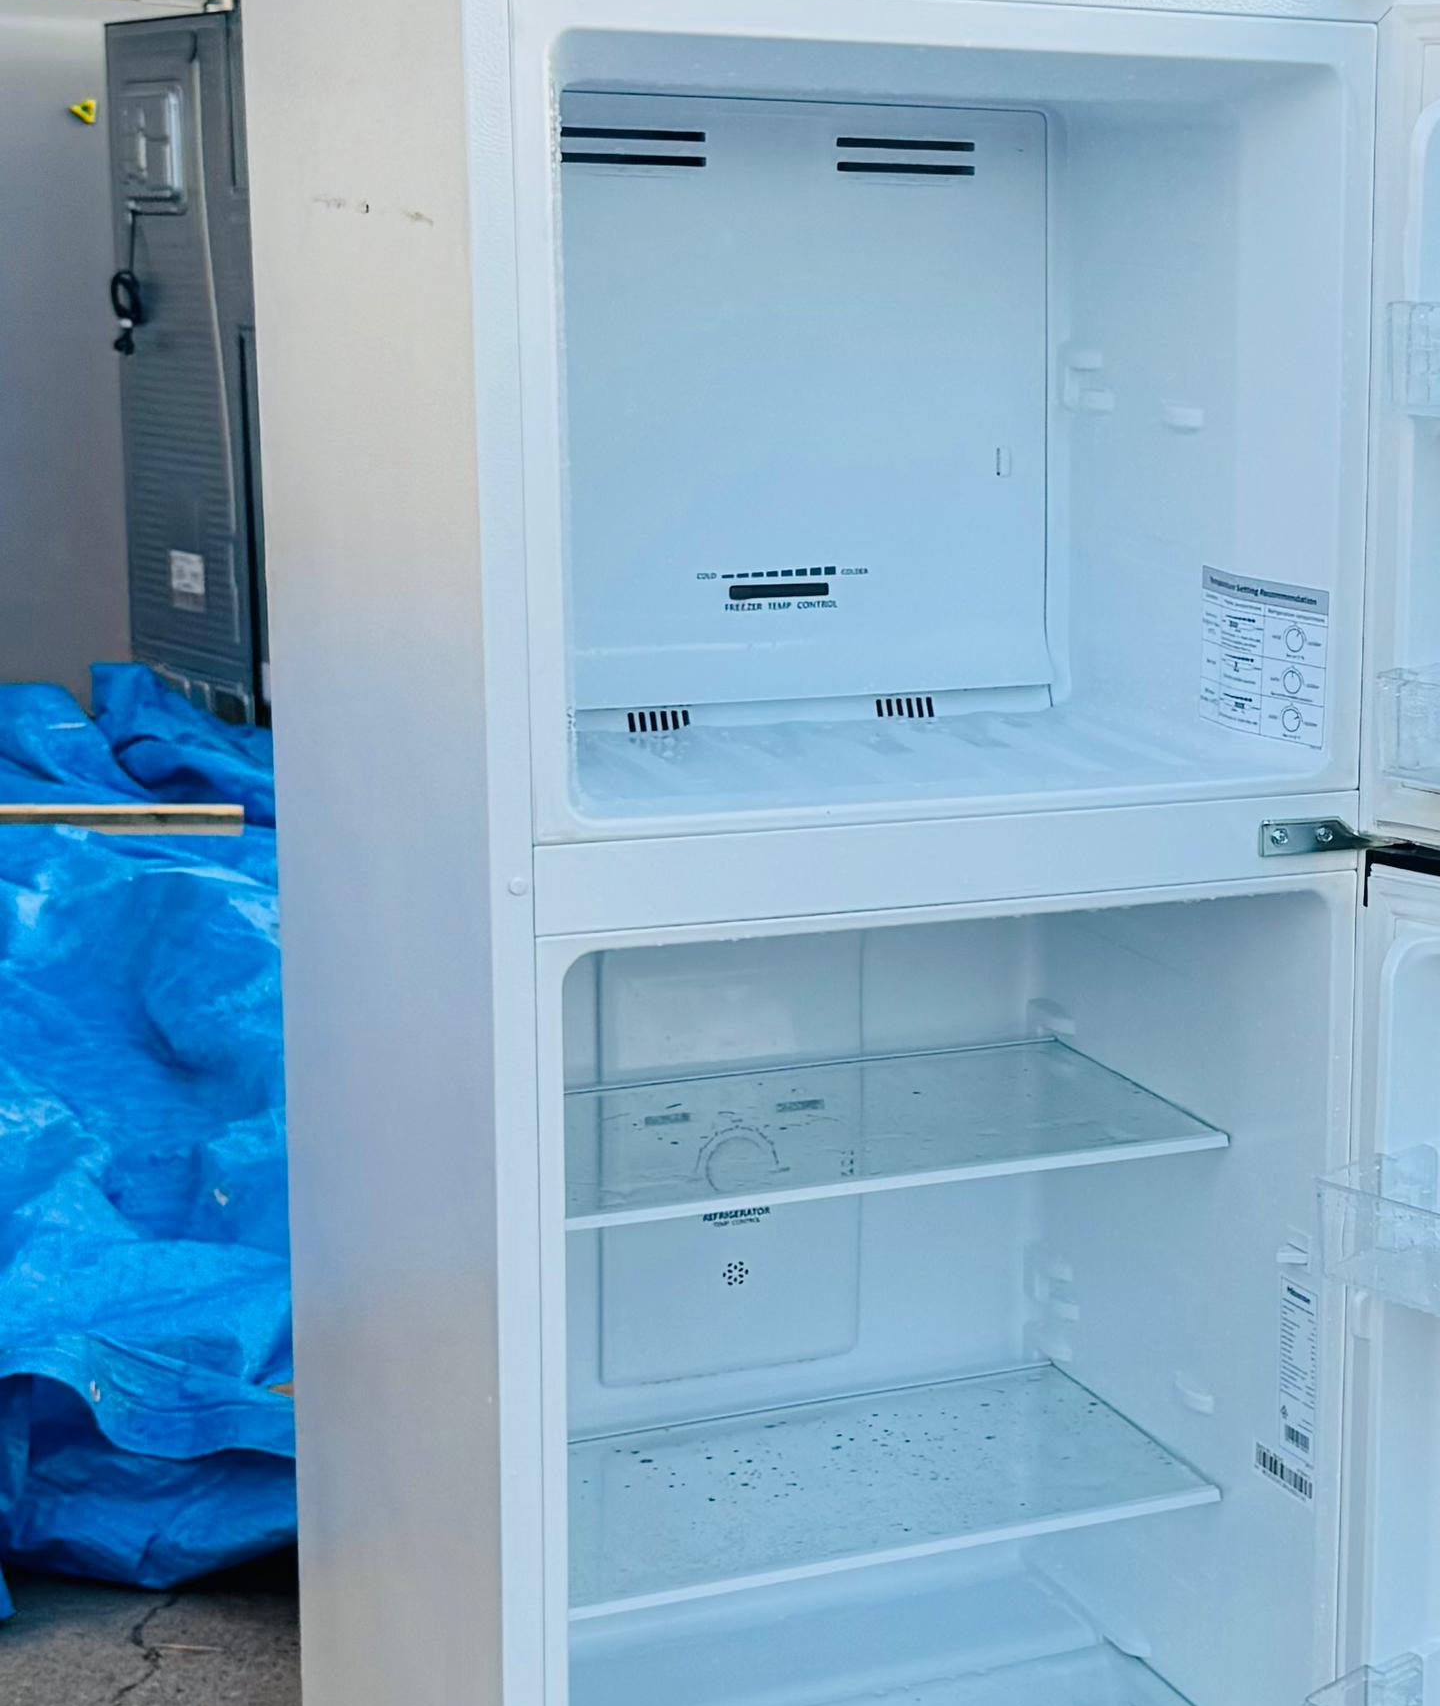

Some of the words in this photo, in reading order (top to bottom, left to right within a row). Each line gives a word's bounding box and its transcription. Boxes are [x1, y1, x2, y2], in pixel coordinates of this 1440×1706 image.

[724, 601, 762, 612] FREEZER
[768, 601, 792, 611] TEMP
[797, 599, 838, 610] CONTROL
[702, 1206, 770, 1221] REFRIGERATOR
